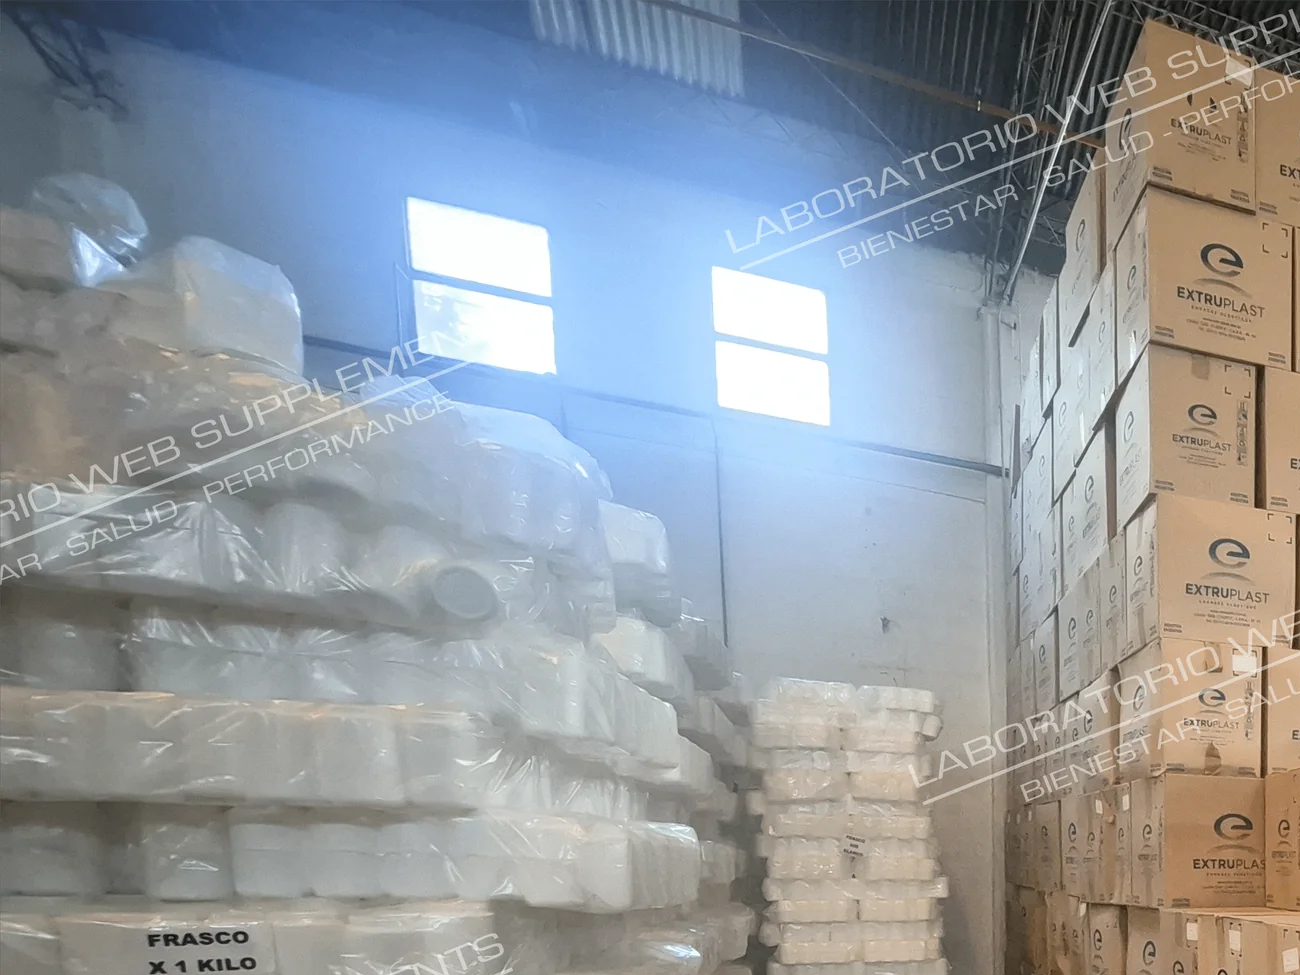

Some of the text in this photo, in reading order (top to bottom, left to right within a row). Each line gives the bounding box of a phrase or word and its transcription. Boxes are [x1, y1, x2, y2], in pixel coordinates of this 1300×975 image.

[1177, 285, 1266, 319] EXTRUPLAST
[1172, 433, 1232, 452] EXTRUPLAST
[1185, 583, 1270, 605] EXTRUPLAST
[1183, 717, 1240, 730] EXTRUPLAST
[147, 931, 249, 947] FRASCO
[149, 957, 256, 975] X 1 KILO
